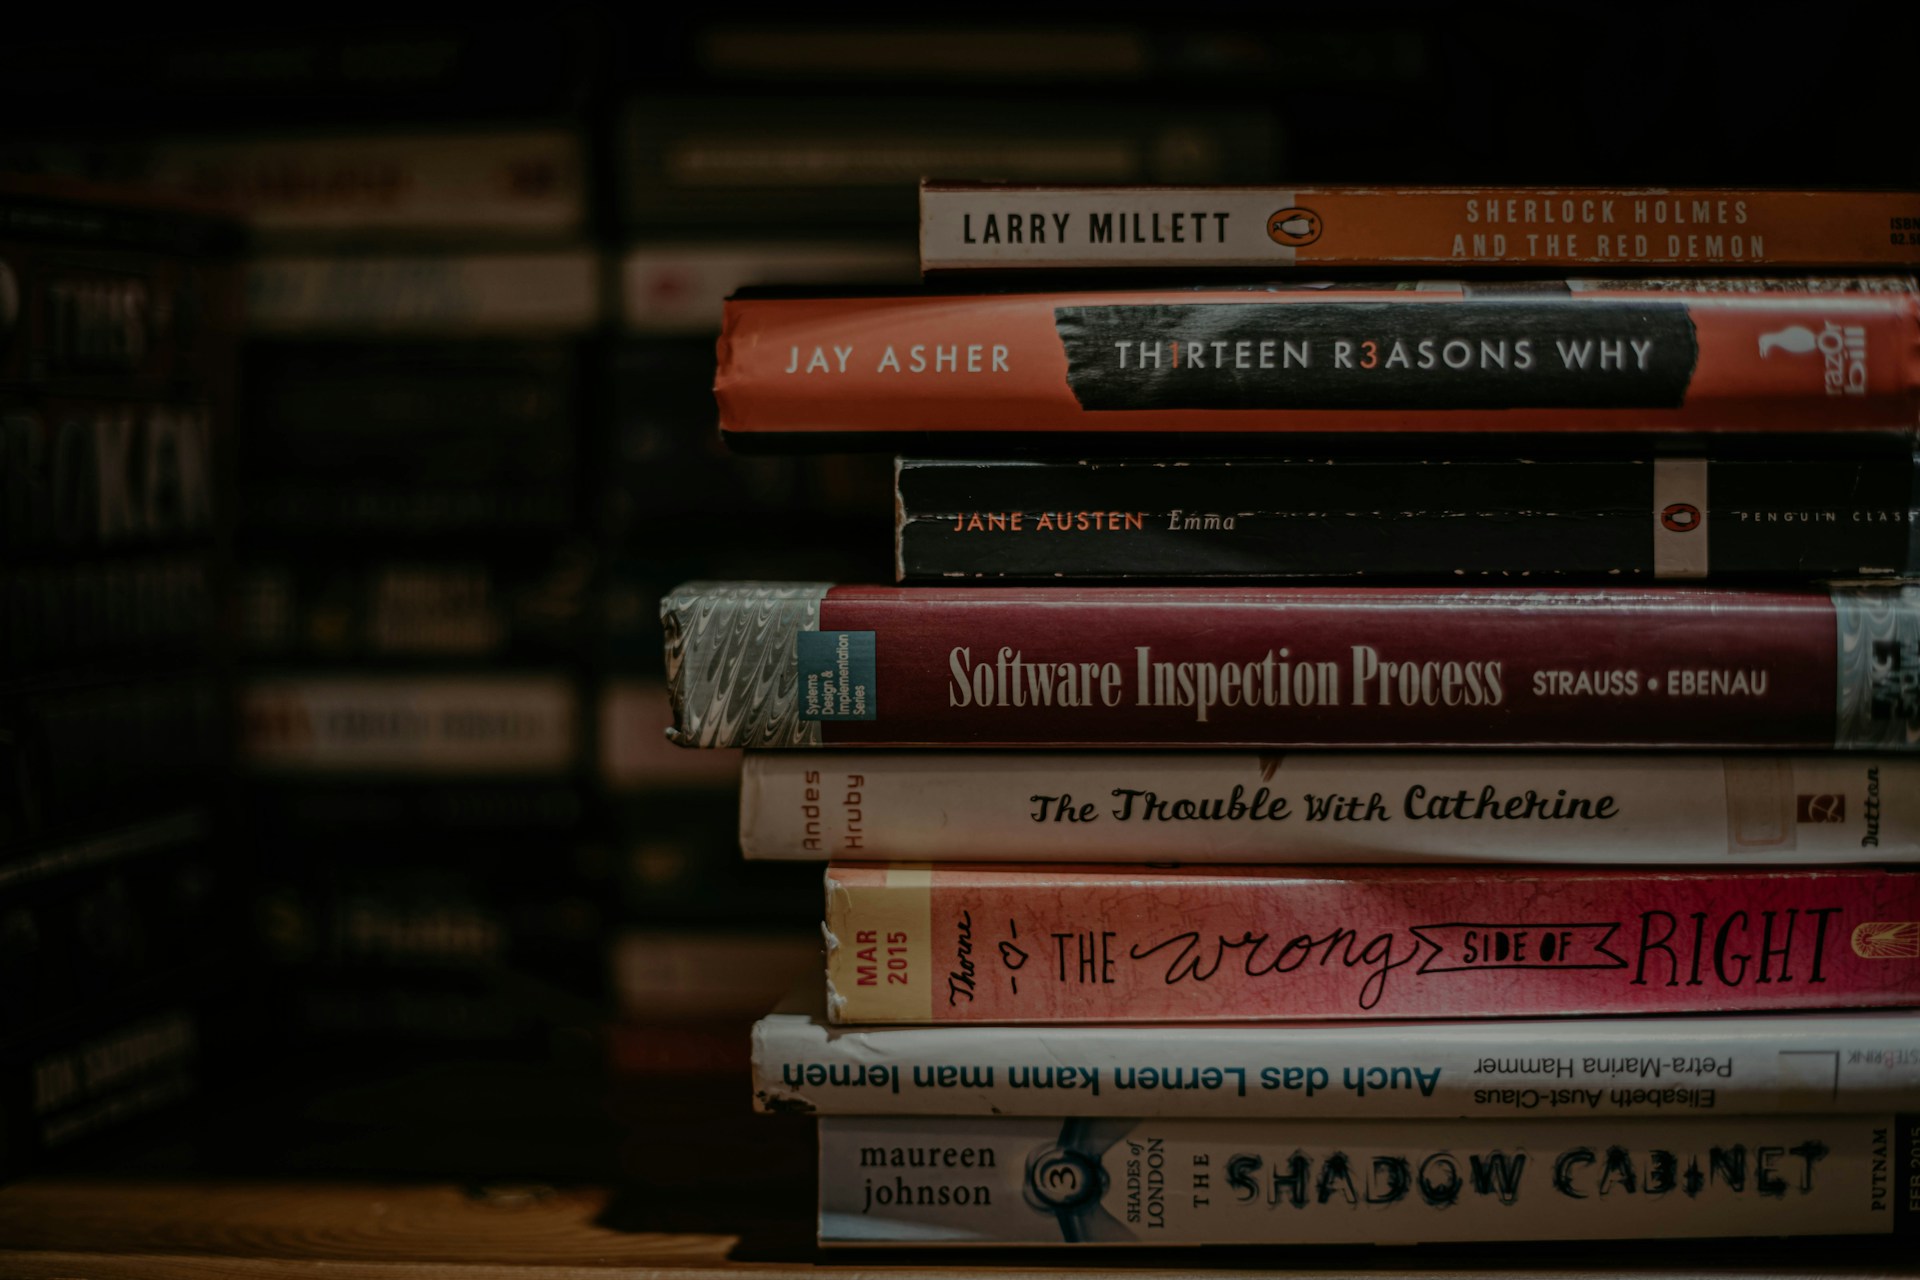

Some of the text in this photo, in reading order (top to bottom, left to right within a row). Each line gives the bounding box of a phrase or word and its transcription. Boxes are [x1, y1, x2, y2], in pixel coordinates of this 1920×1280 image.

[963, 212, 1230, 244] LARRY MILLETT
[1466, 199, 1748, 225] SHERLOCK HOLMES
[1451, 234, 1764, 259] AND THE RED DEMON
[785, 344, 1010, 374] JAY ASHER
[1334, 340, 1534, 370] R3ASONS
[1556, 340, 1652, 371] WHY
[953, 509, 1236, 532] JANE AUSTEN Emma
[1740, 511, 1836, 522] PENGUIN
[837, 634, 852, 715] Implementation
[949, 645, 1504, 722] Software Inspection Process
[1533, 670, 1767, 696] STRAUSS EBENAU
[806, 674, 821, 715] Systems
[821, 681, 837, 715] Design
[853, 685, 865, 715] Series
[802, 770, 822, 850] Andes
[843, 774, 865, 849] Hruby
[1030, 784, 1620, 824] The Trouble With Catherine
[1861, 766, 1880, 848] Dutton
[857, 929, 878, 986] MAR
[887, 931, 908, 985] 2015
[949, 910, 976, 1006] Thorne
[1051, 907, 1843, 1010] THE wrong SIDE OF RIGHT
[783, 1063, 1442, 1097] Auch das Lernen kann man lernen
[1474, 1057, 1733, 1079] Petra-Marina Hammer
[1474, 1087, 1716, 1109] Elisabeth Aust-Claus
[860, 1146, 995, 1168] maureen
[1193, 1139, 1829, 1210] THE SHADOW CABINET
[1871, 1127, 1887, 1212] PUTNAM
[862, 1178, 991, 1214] johnson
[1050, 1166, 1076, 1190] 3
[1126, 1140, 1145, 1223] SHADES of
[1147, 1137, 1164, 1229] LONDON
